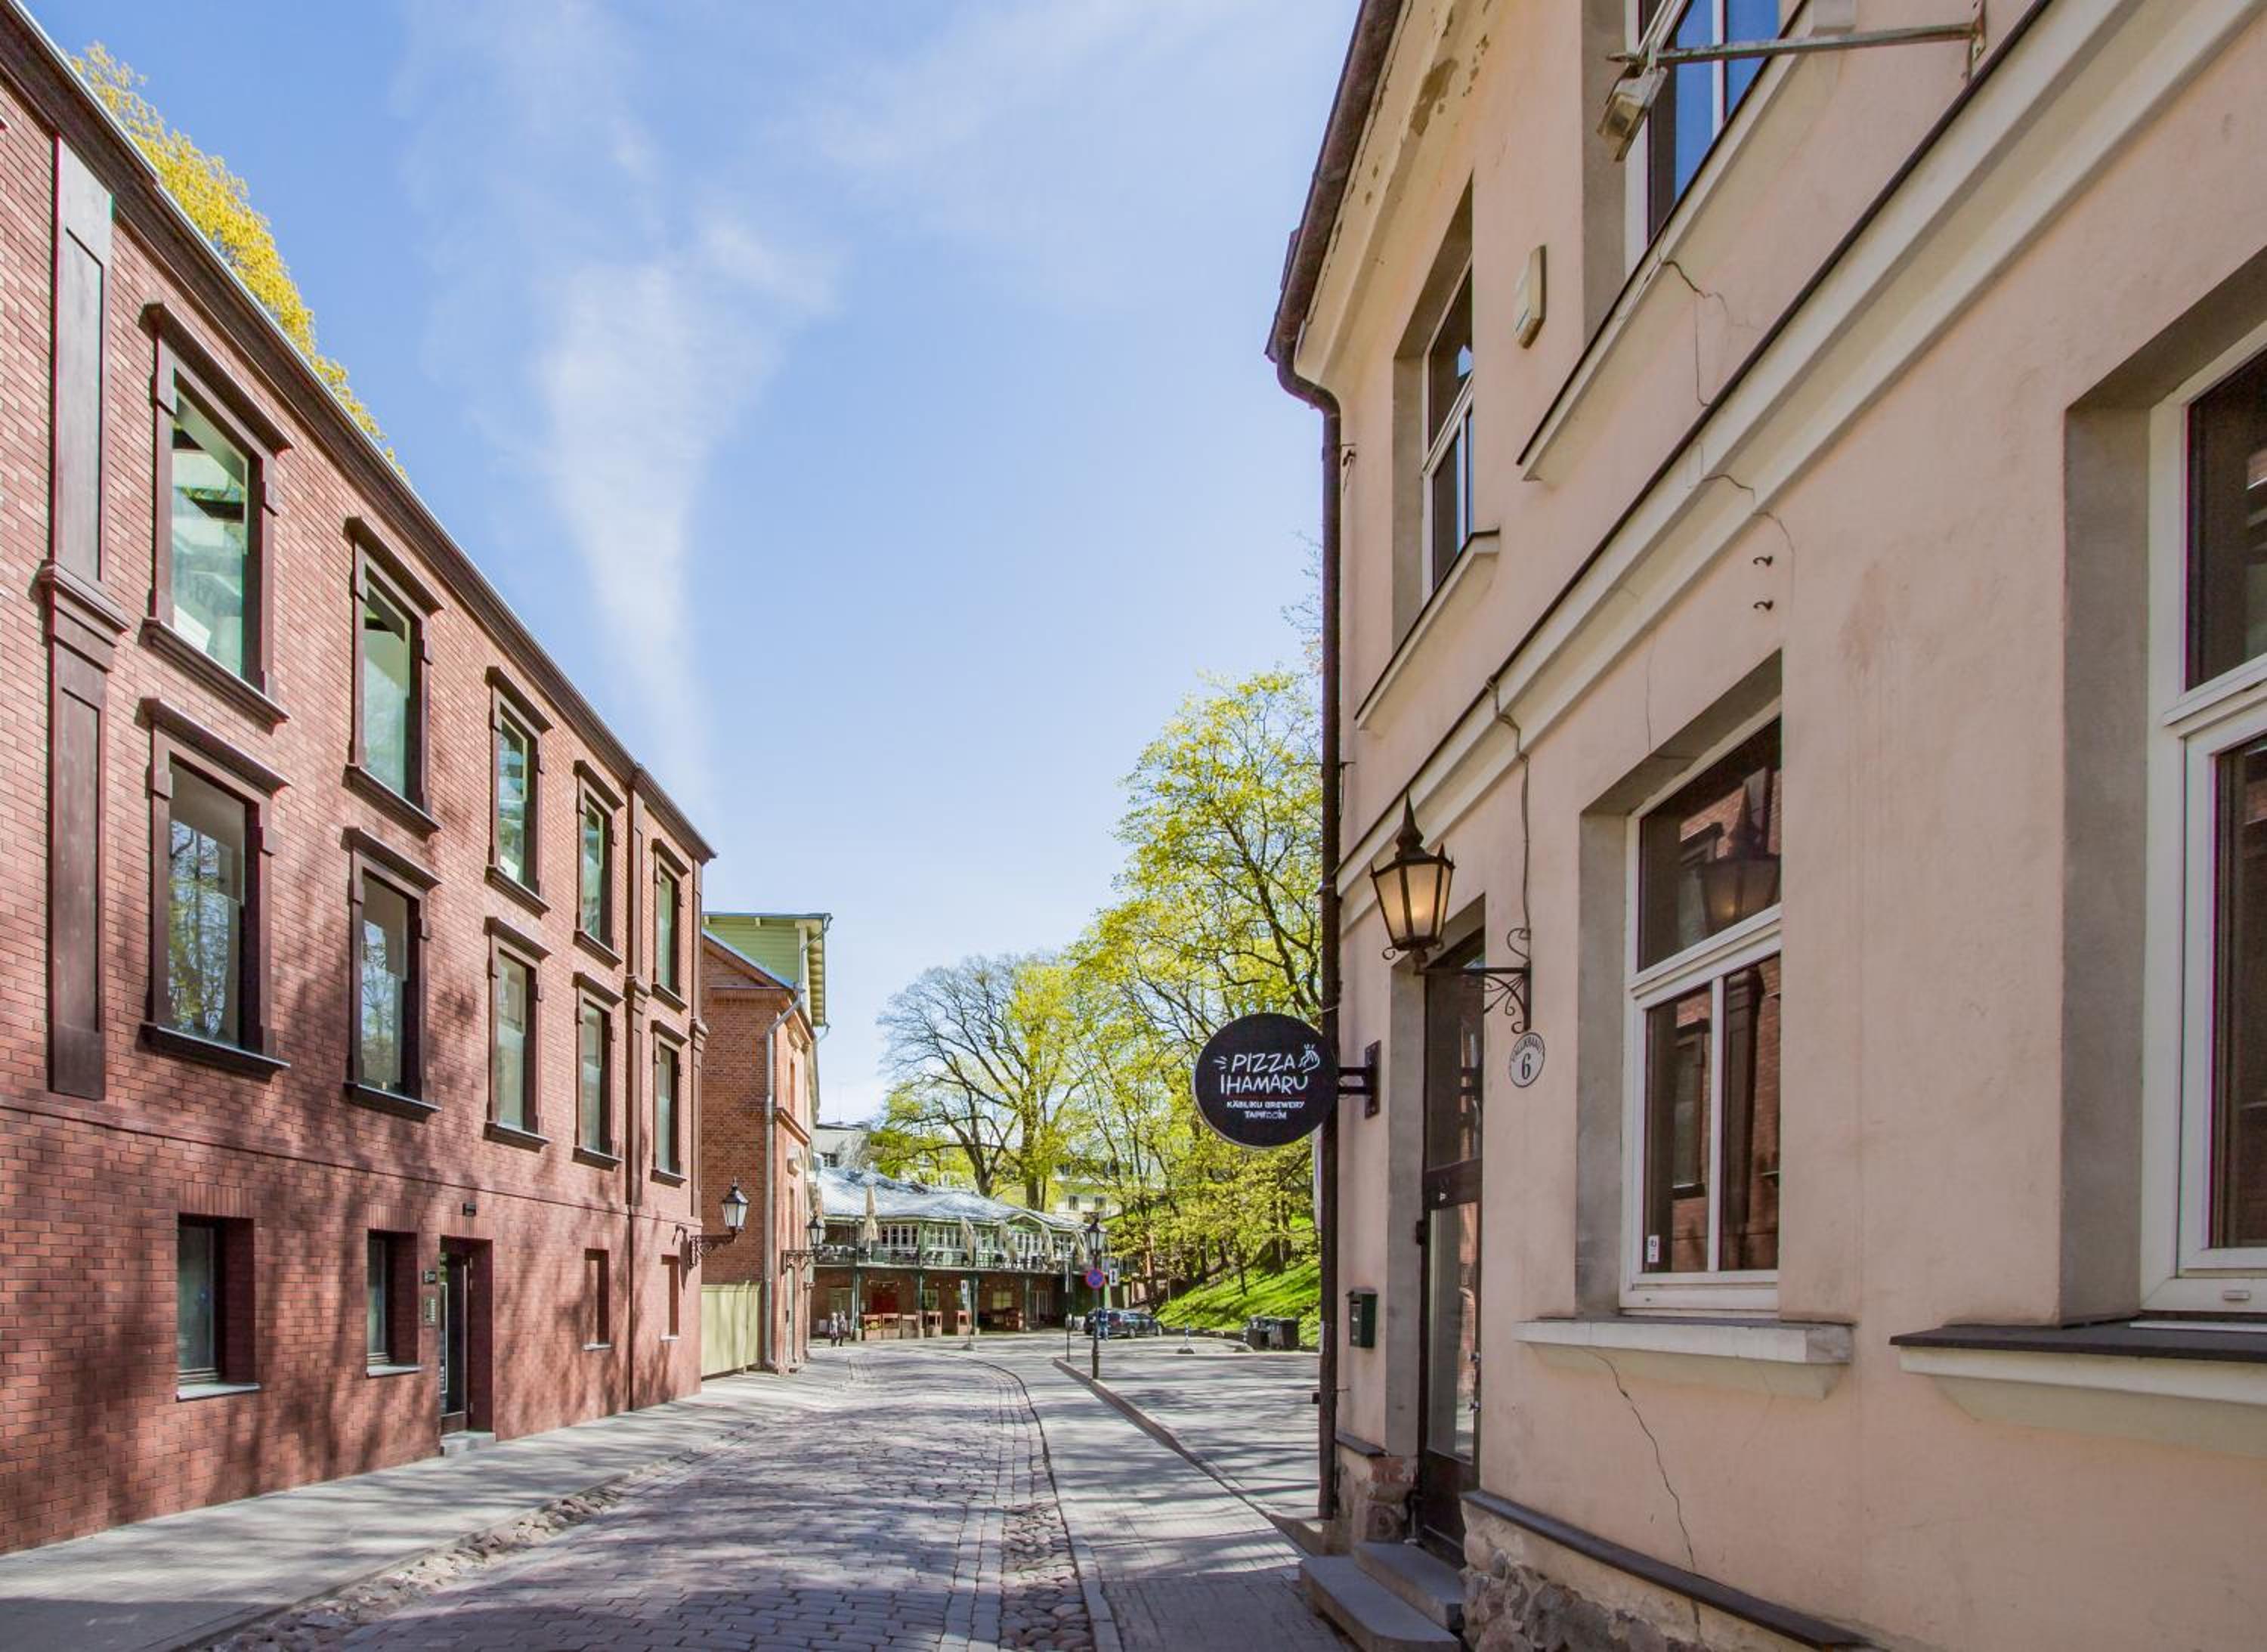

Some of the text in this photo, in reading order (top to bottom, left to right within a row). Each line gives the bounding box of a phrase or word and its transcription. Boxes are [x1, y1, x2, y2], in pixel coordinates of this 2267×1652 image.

[1232, 1053, 1295, 1072] PIZZA
[1521, 1053, 1531, 1079] 6
[1220, 1074, 1307, 1095] IHAMARU
[1245, 1111, 1287, 1119] TAPROOM
